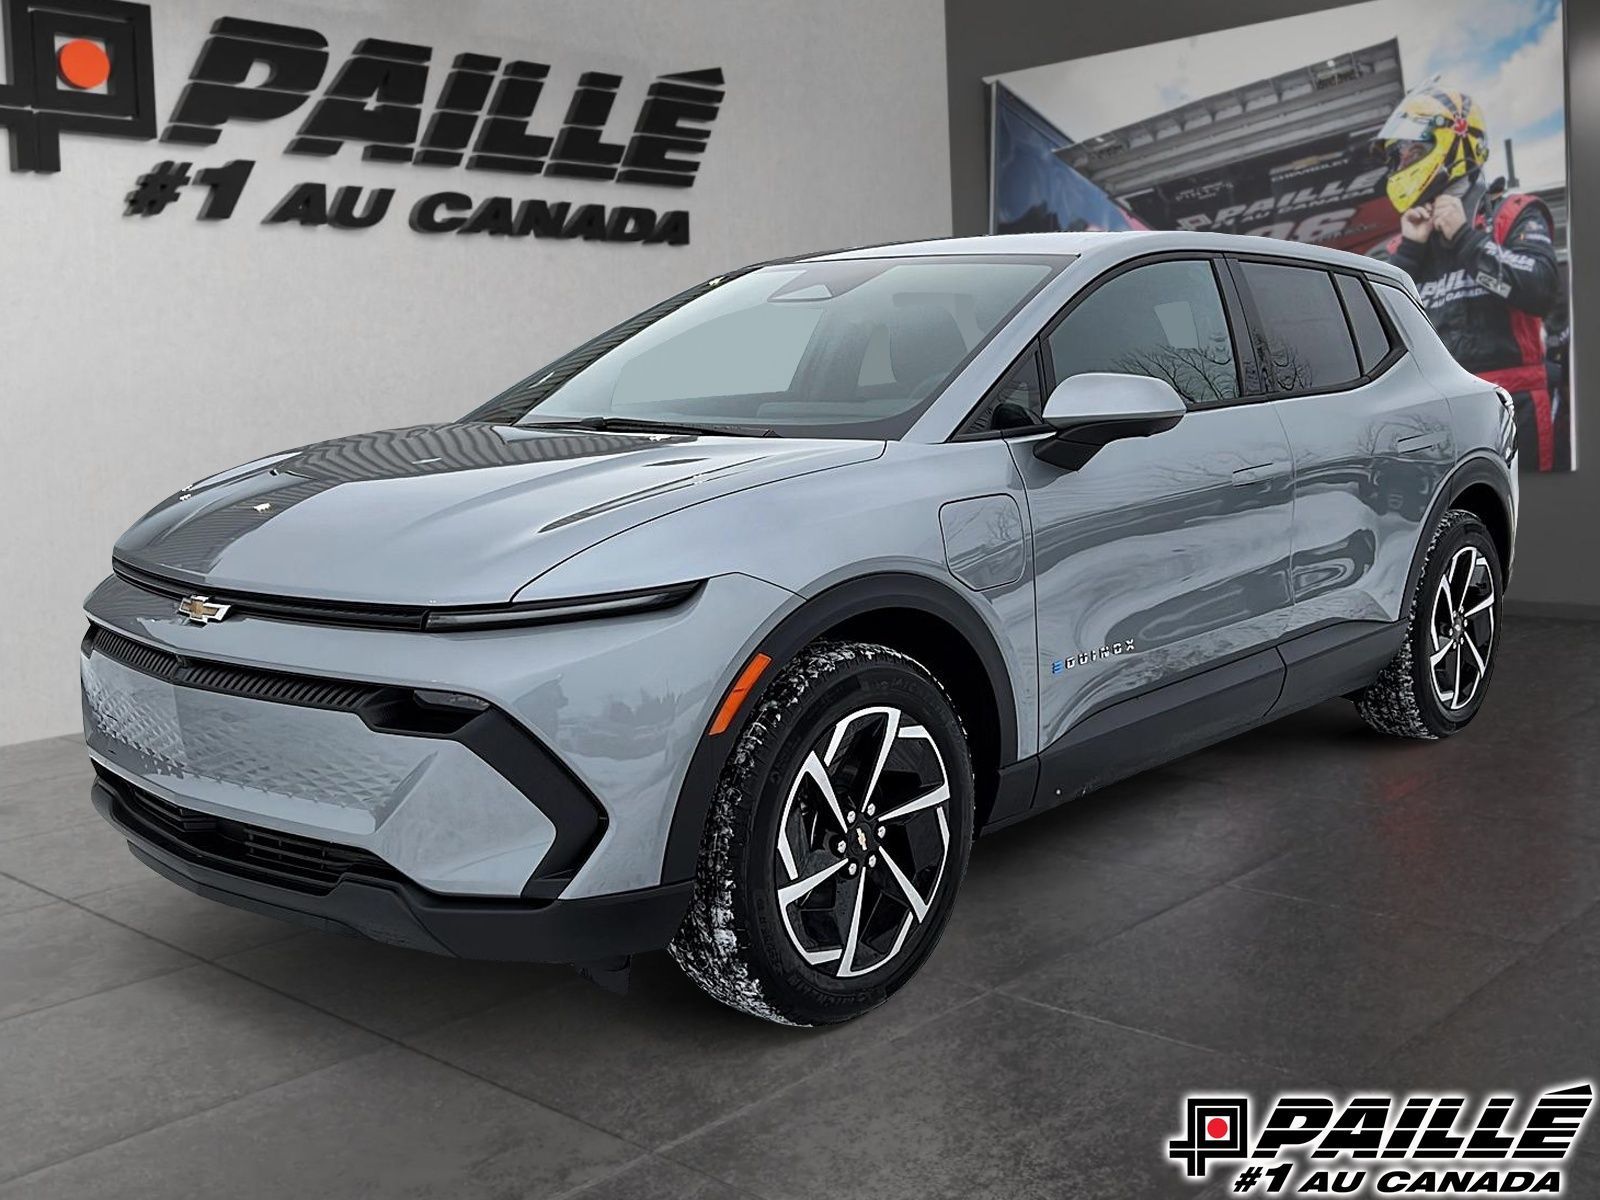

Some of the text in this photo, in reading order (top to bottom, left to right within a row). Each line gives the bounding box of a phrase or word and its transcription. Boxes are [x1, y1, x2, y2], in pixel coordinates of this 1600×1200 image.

[161, 16, 725, 188] PAILLÉ
[123, 159, 690, 246] #1 AU CANADA
[1051, 638, 1135, 675] EQUINOX
